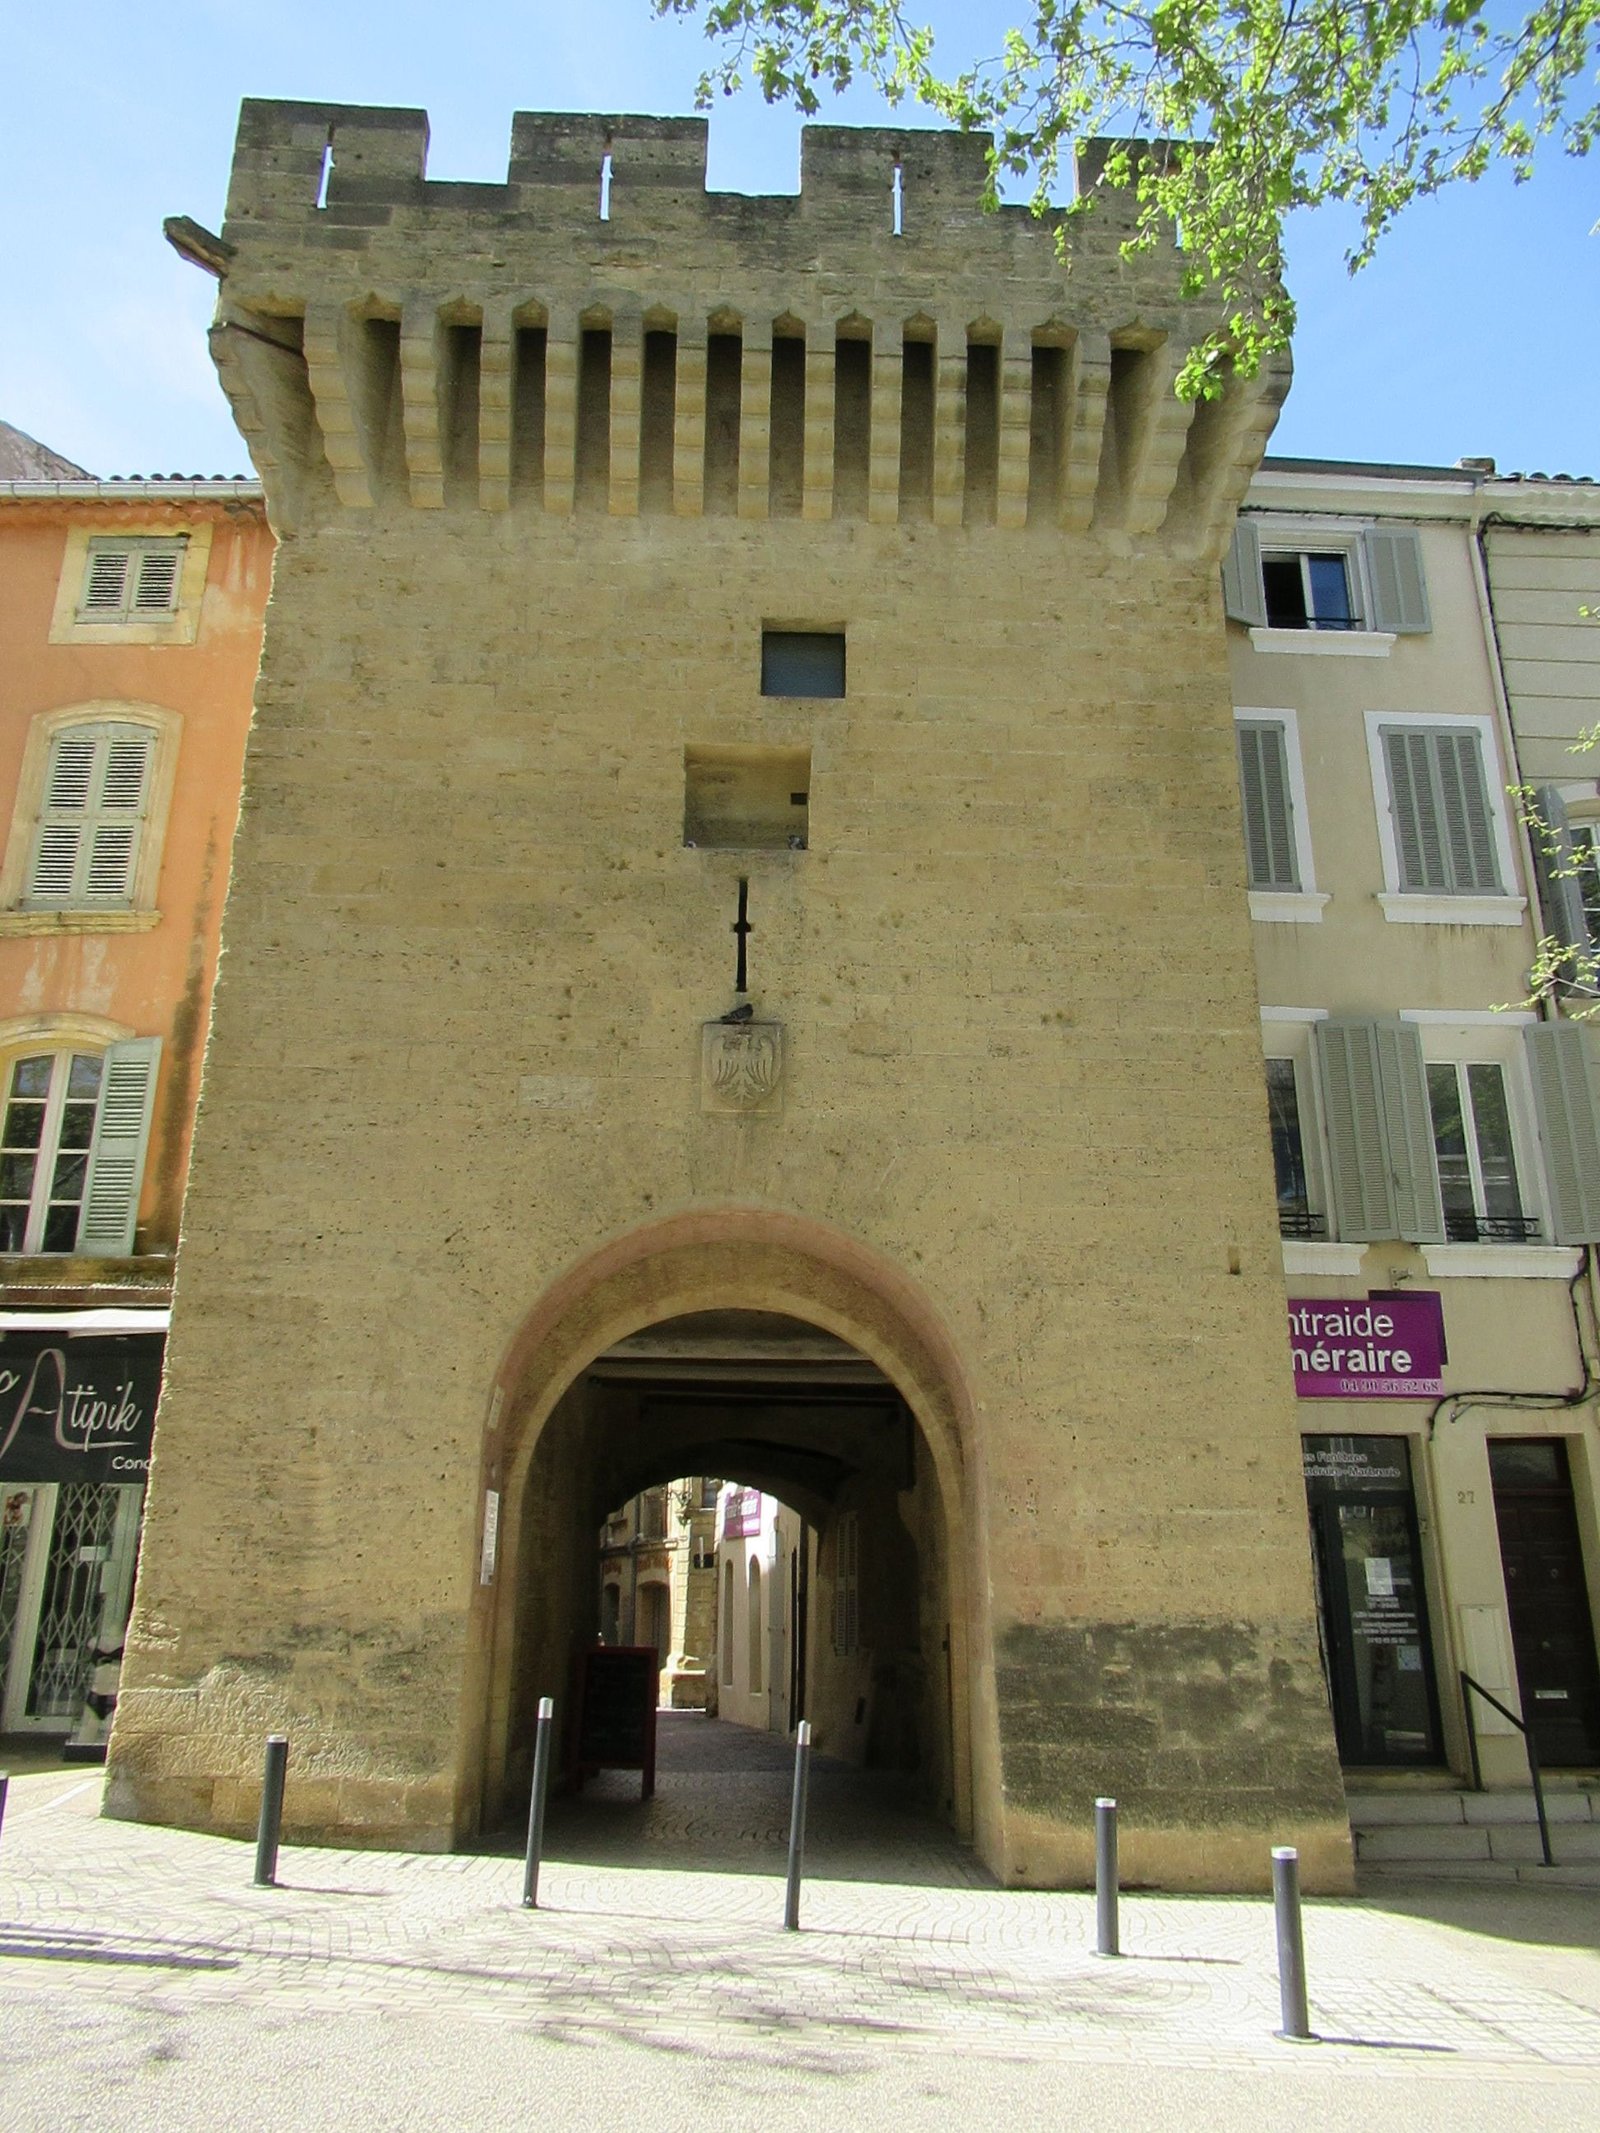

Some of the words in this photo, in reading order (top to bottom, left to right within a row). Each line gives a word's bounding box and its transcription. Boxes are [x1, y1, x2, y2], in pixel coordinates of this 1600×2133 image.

[1288, 1307, 1394, 1337] ntraide
[1292, 1341, 1412, 1373] néraire
[1341, 1379, 1358, 1393] 04
[1361, 1379, 1378, 1393] 90
[1382, 1380, 1398, 1393] 56
[1403, 1380, 1418, 1393] 52
[1423, 1381, 1439, 1393] 68
[0, 1349, 142, 1458] Atipik
[1457, 1490, 1475, 1504] 27
